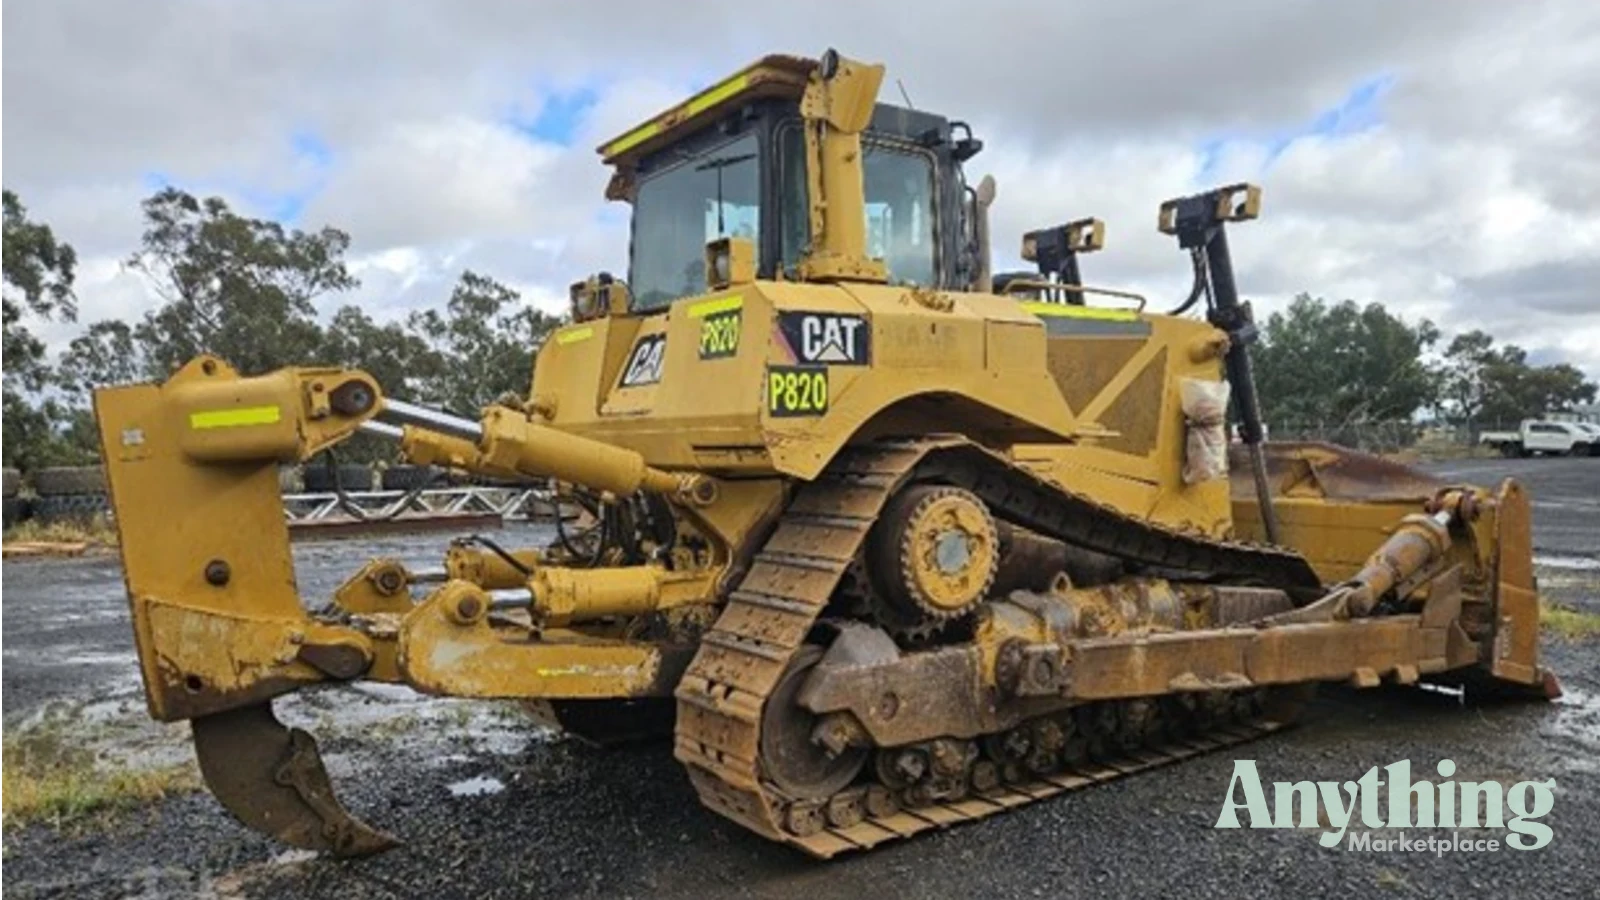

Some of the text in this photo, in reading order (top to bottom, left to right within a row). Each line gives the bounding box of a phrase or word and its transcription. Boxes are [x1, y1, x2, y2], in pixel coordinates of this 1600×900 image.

[701, 315, 738, 353] P820
[802, 316, 863, 361] CAT
[624, 340, 665, 385] CA
[770, 372, 826, 410] P820
